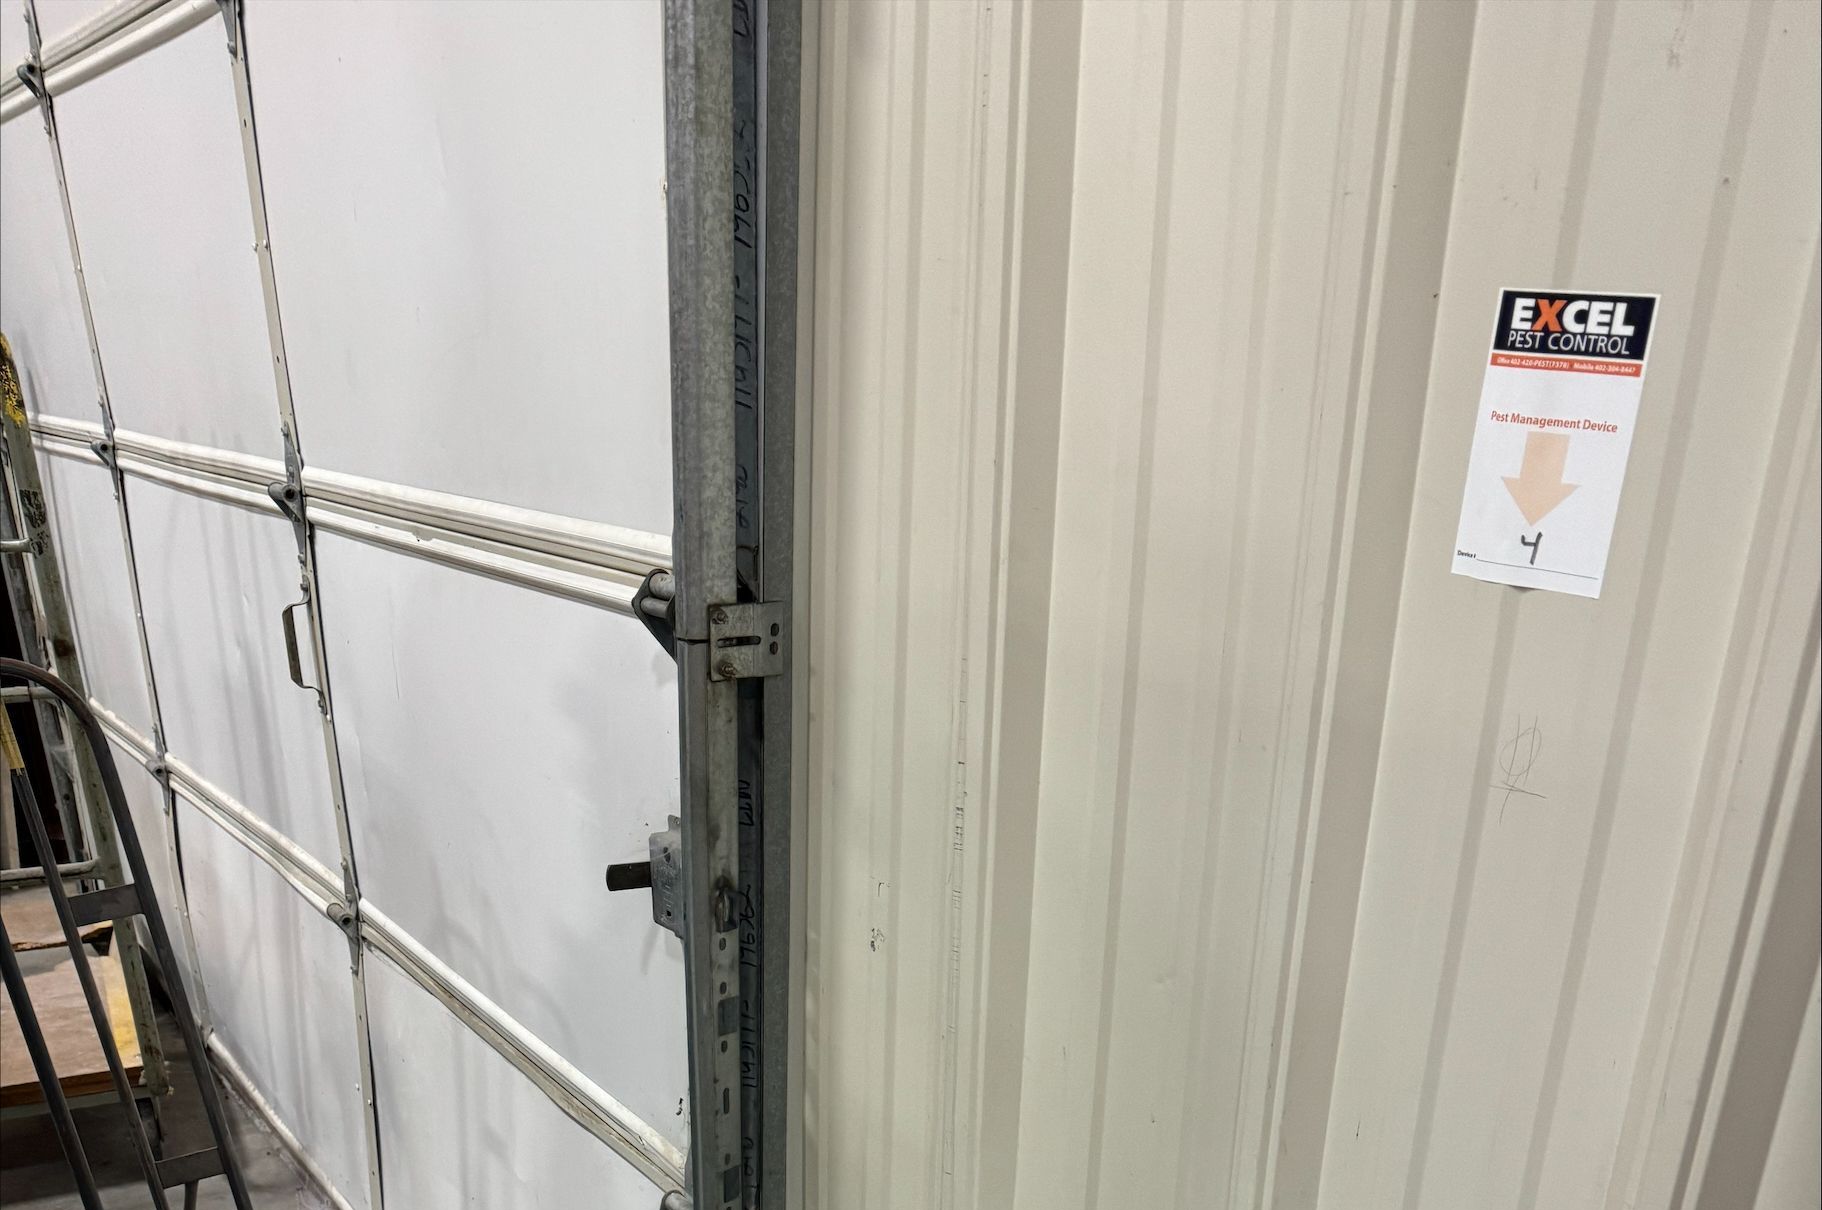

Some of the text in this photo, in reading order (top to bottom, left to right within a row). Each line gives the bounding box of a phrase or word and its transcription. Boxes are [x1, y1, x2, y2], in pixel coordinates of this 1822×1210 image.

[1510, 297, 1635, 336] EXCEL
[1507, 331, 1630, 354] PEST CONTROL
[1490, 410, 1618, 433] Pest Management Device
[1521, 531, 1543, 565] 4
